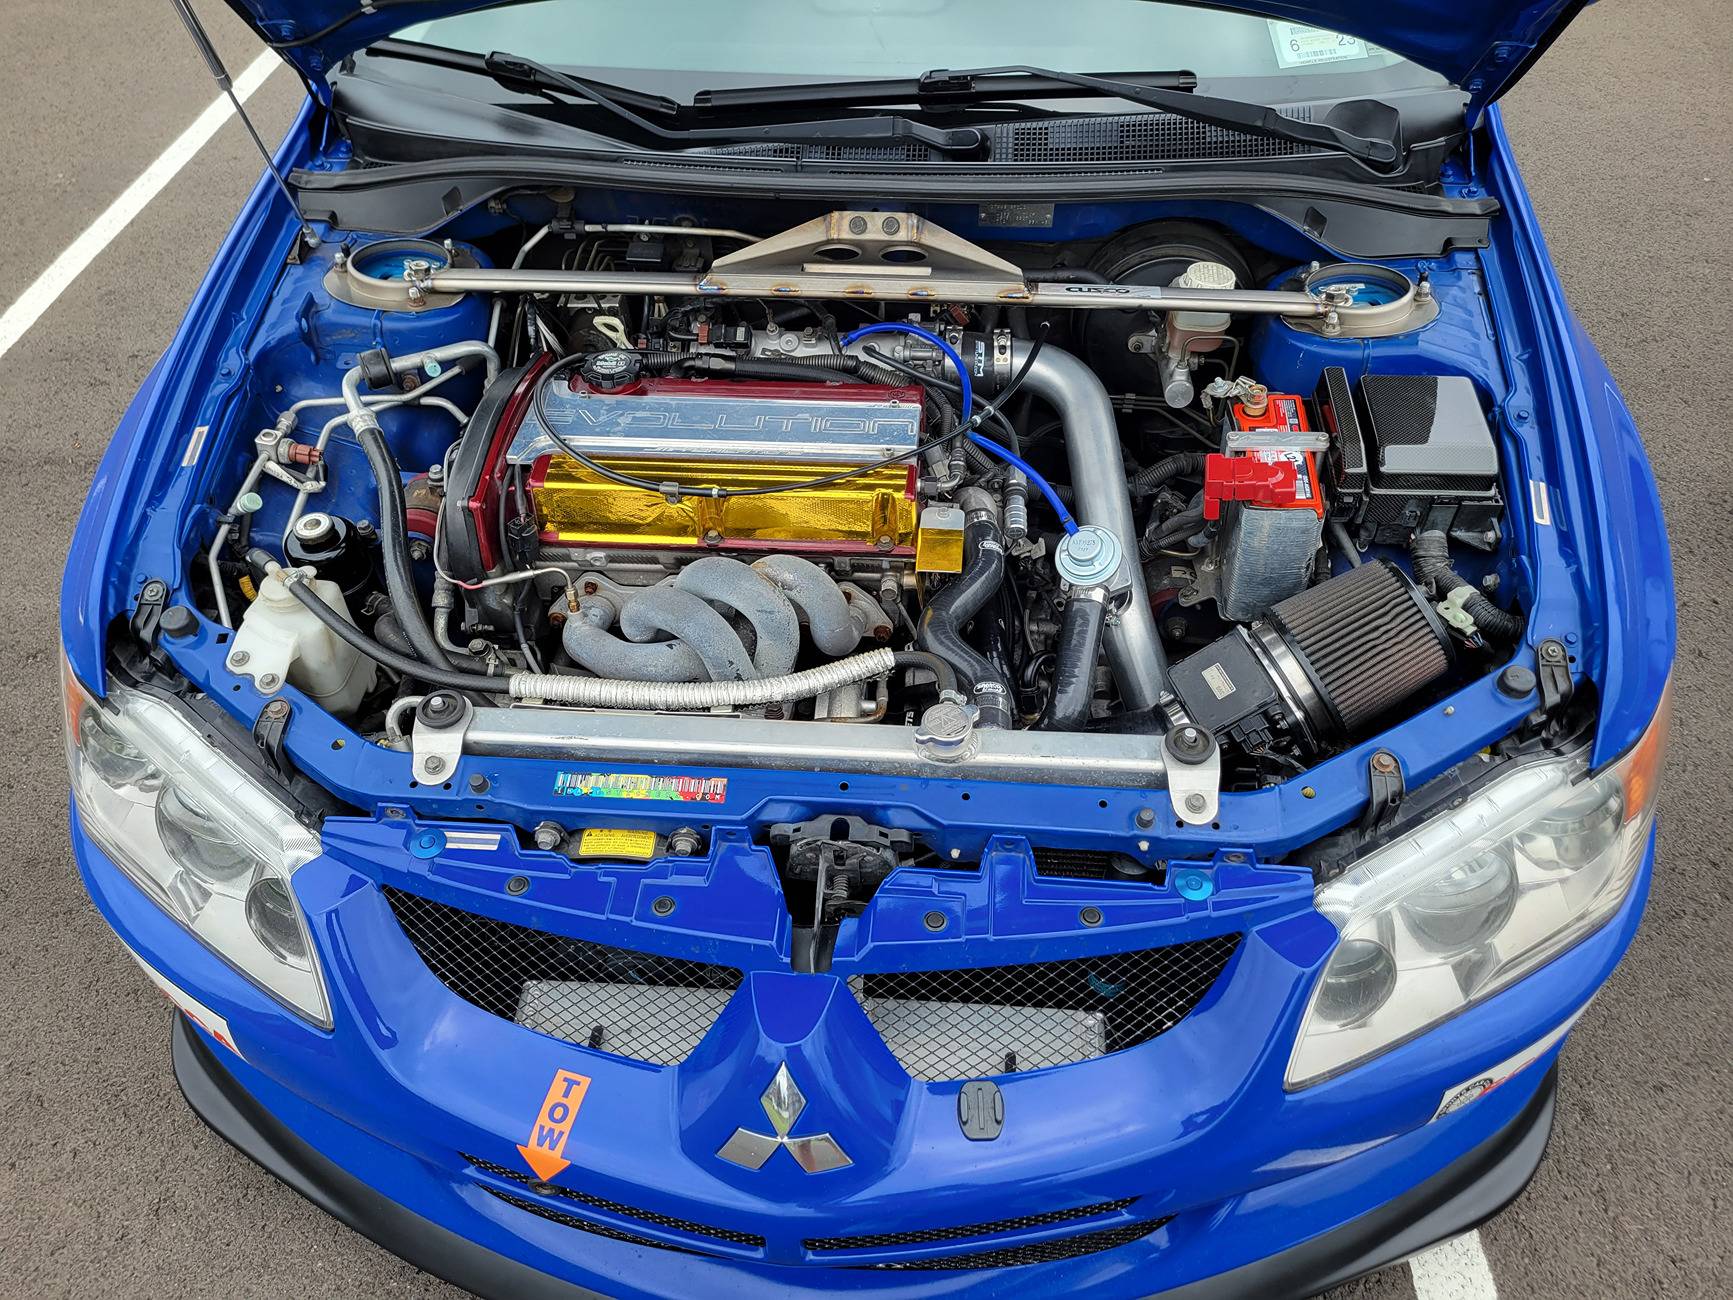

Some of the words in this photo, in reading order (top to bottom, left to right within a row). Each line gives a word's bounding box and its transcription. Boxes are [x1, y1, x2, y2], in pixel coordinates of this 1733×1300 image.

[1289, 39, 1300, 52] 6
[525, 407, 917, 436] EVOLUTION
[536, 1077, 581, 1151] TOW
